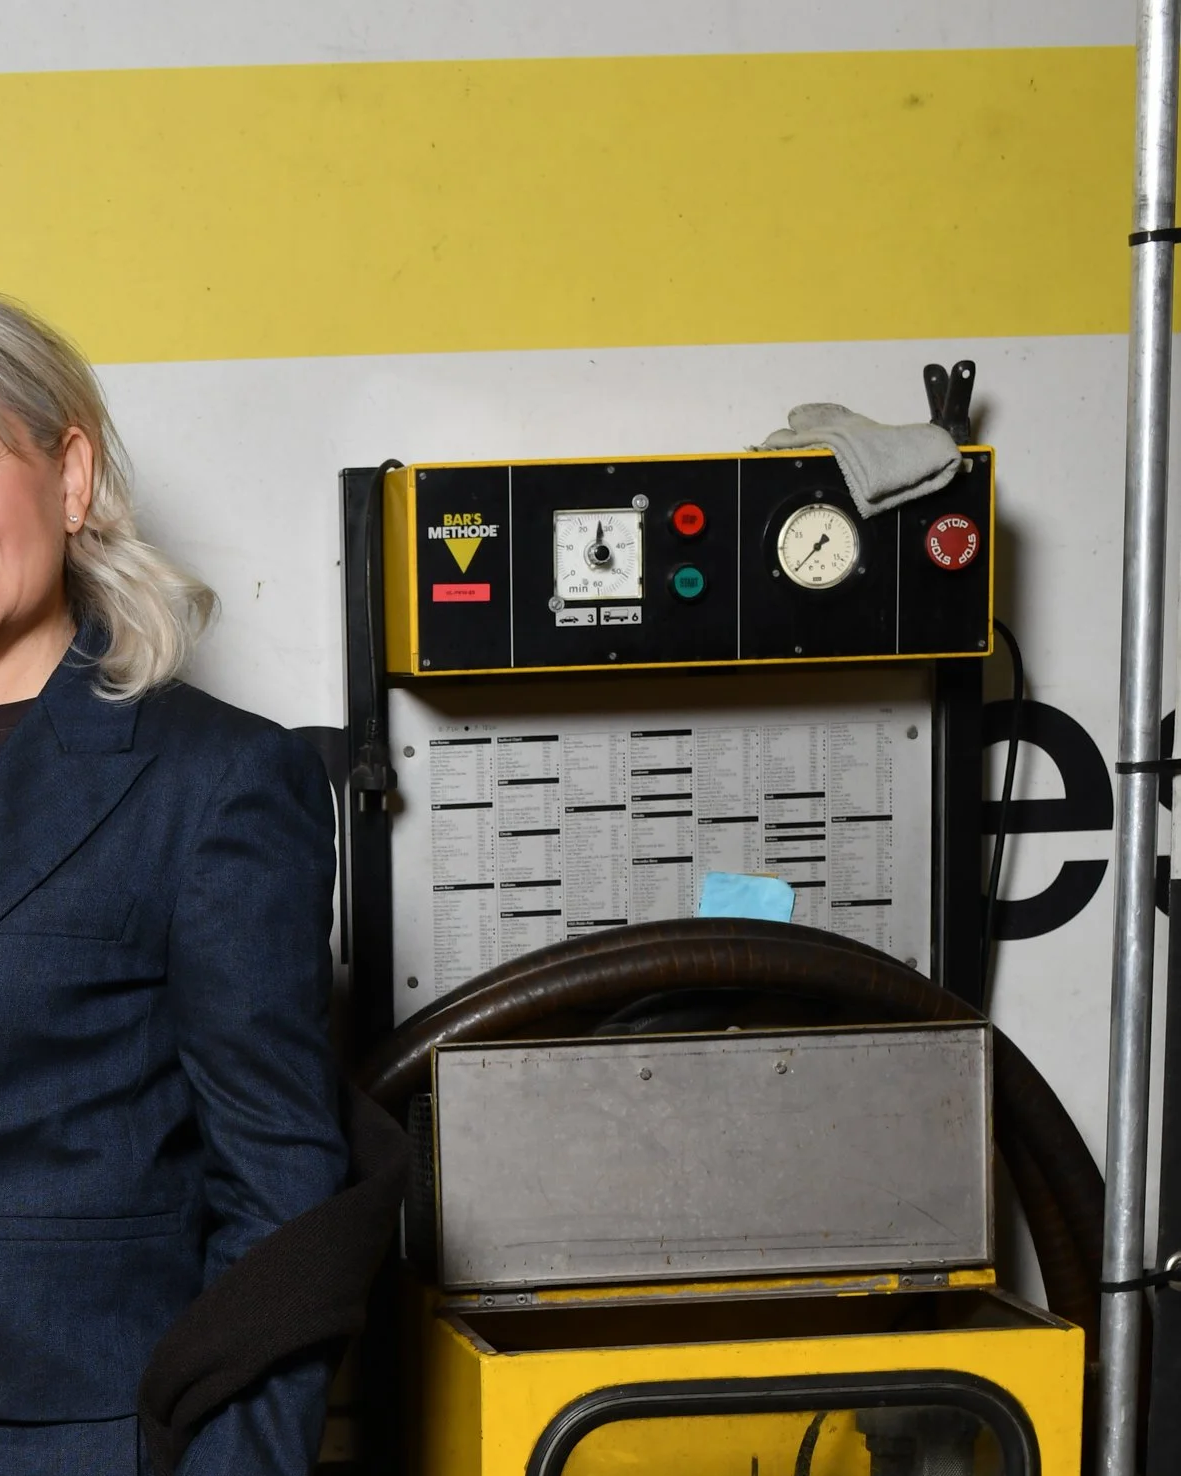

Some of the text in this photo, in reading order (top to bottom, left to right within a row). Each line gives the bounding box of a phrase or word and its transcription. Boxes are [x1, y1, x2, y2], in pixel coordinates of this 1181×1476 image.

[443, 512, 483, 527] BAR'S
[936, 517, 969, 533] STOP
[427, 525, 498, 540] METHODE
[615, 542, 626, 550] 40
[930, 536, 952, 566] STOP
[958, 533, 977, 565] STOP
[570, 569, 576, 577] 0
[568, 584, 589, 593] min
[593, 580, 603, 588] 60
[587, 614, 595, 624] 3
[631, 611, 639, 622] 6
